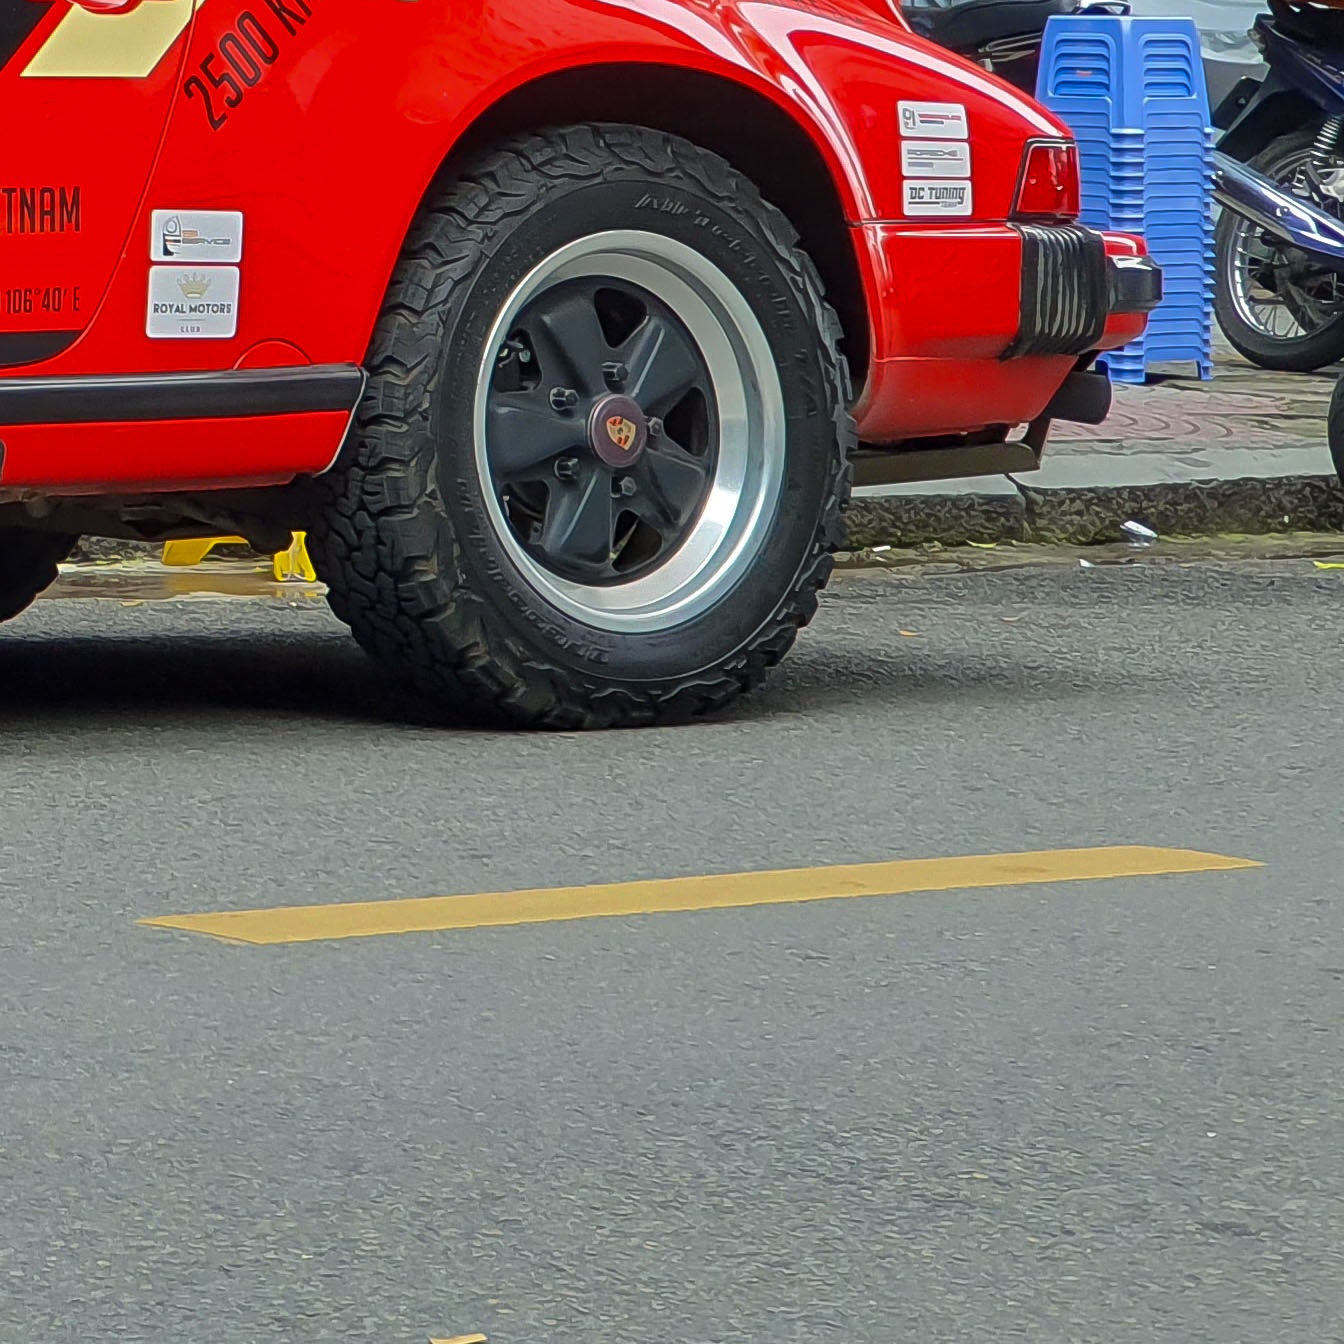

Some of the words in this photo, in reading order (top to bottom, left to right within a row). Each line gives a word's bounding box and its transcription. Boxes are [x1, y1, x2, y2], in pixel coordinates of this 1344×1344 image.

[183, 10, 280, 131] 2500
[153, 303, 187, 314] ROYAL
[189, 303, 232, 314] MOTORS
